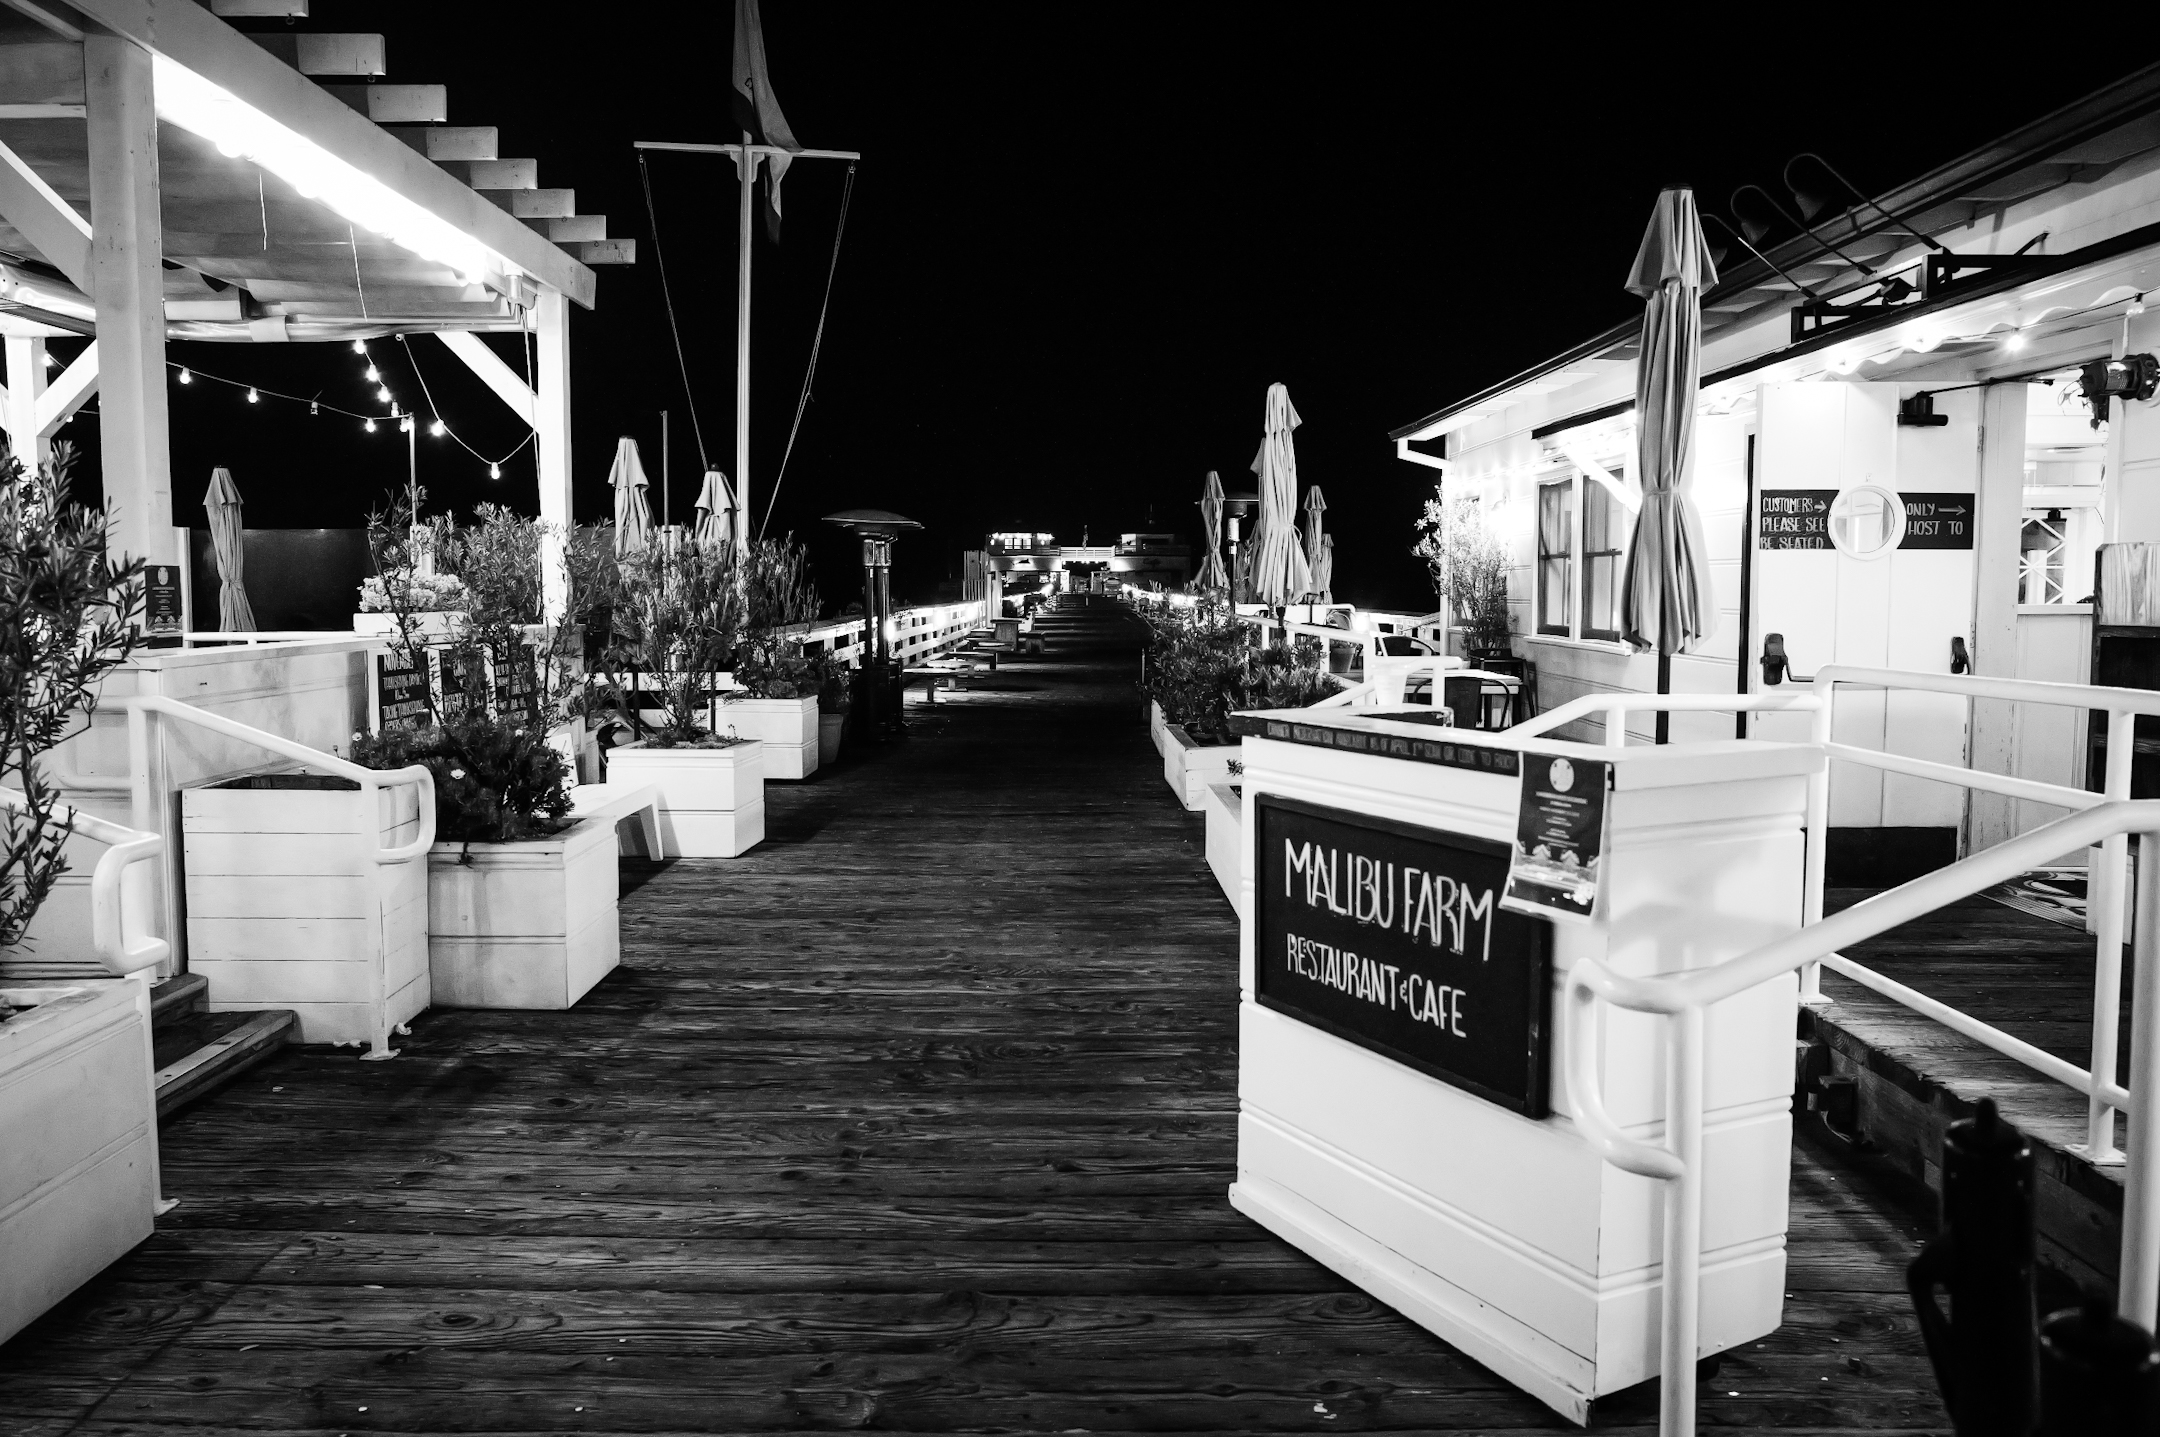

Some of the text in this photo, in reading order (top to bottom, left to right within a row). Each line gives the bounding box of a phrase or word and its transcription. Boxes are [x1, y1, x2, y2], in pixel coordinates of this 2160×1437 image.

[1762, 497, 1814, 514] CUSTOMERS
[1907, 503, 1936, 516] ONLY
[1762, 517, 1825, 533] PLEASE SEE
[1908, 520, 1964, 535] HOST TO
[1760, 537, 1825, 549] BE SEATED
[1285, 838, 1494, 962] MALIBU FARM
[1287, 933, 1400, 1011] RESTAURANT
[1409, 973, 1468, 1038] CAFE
